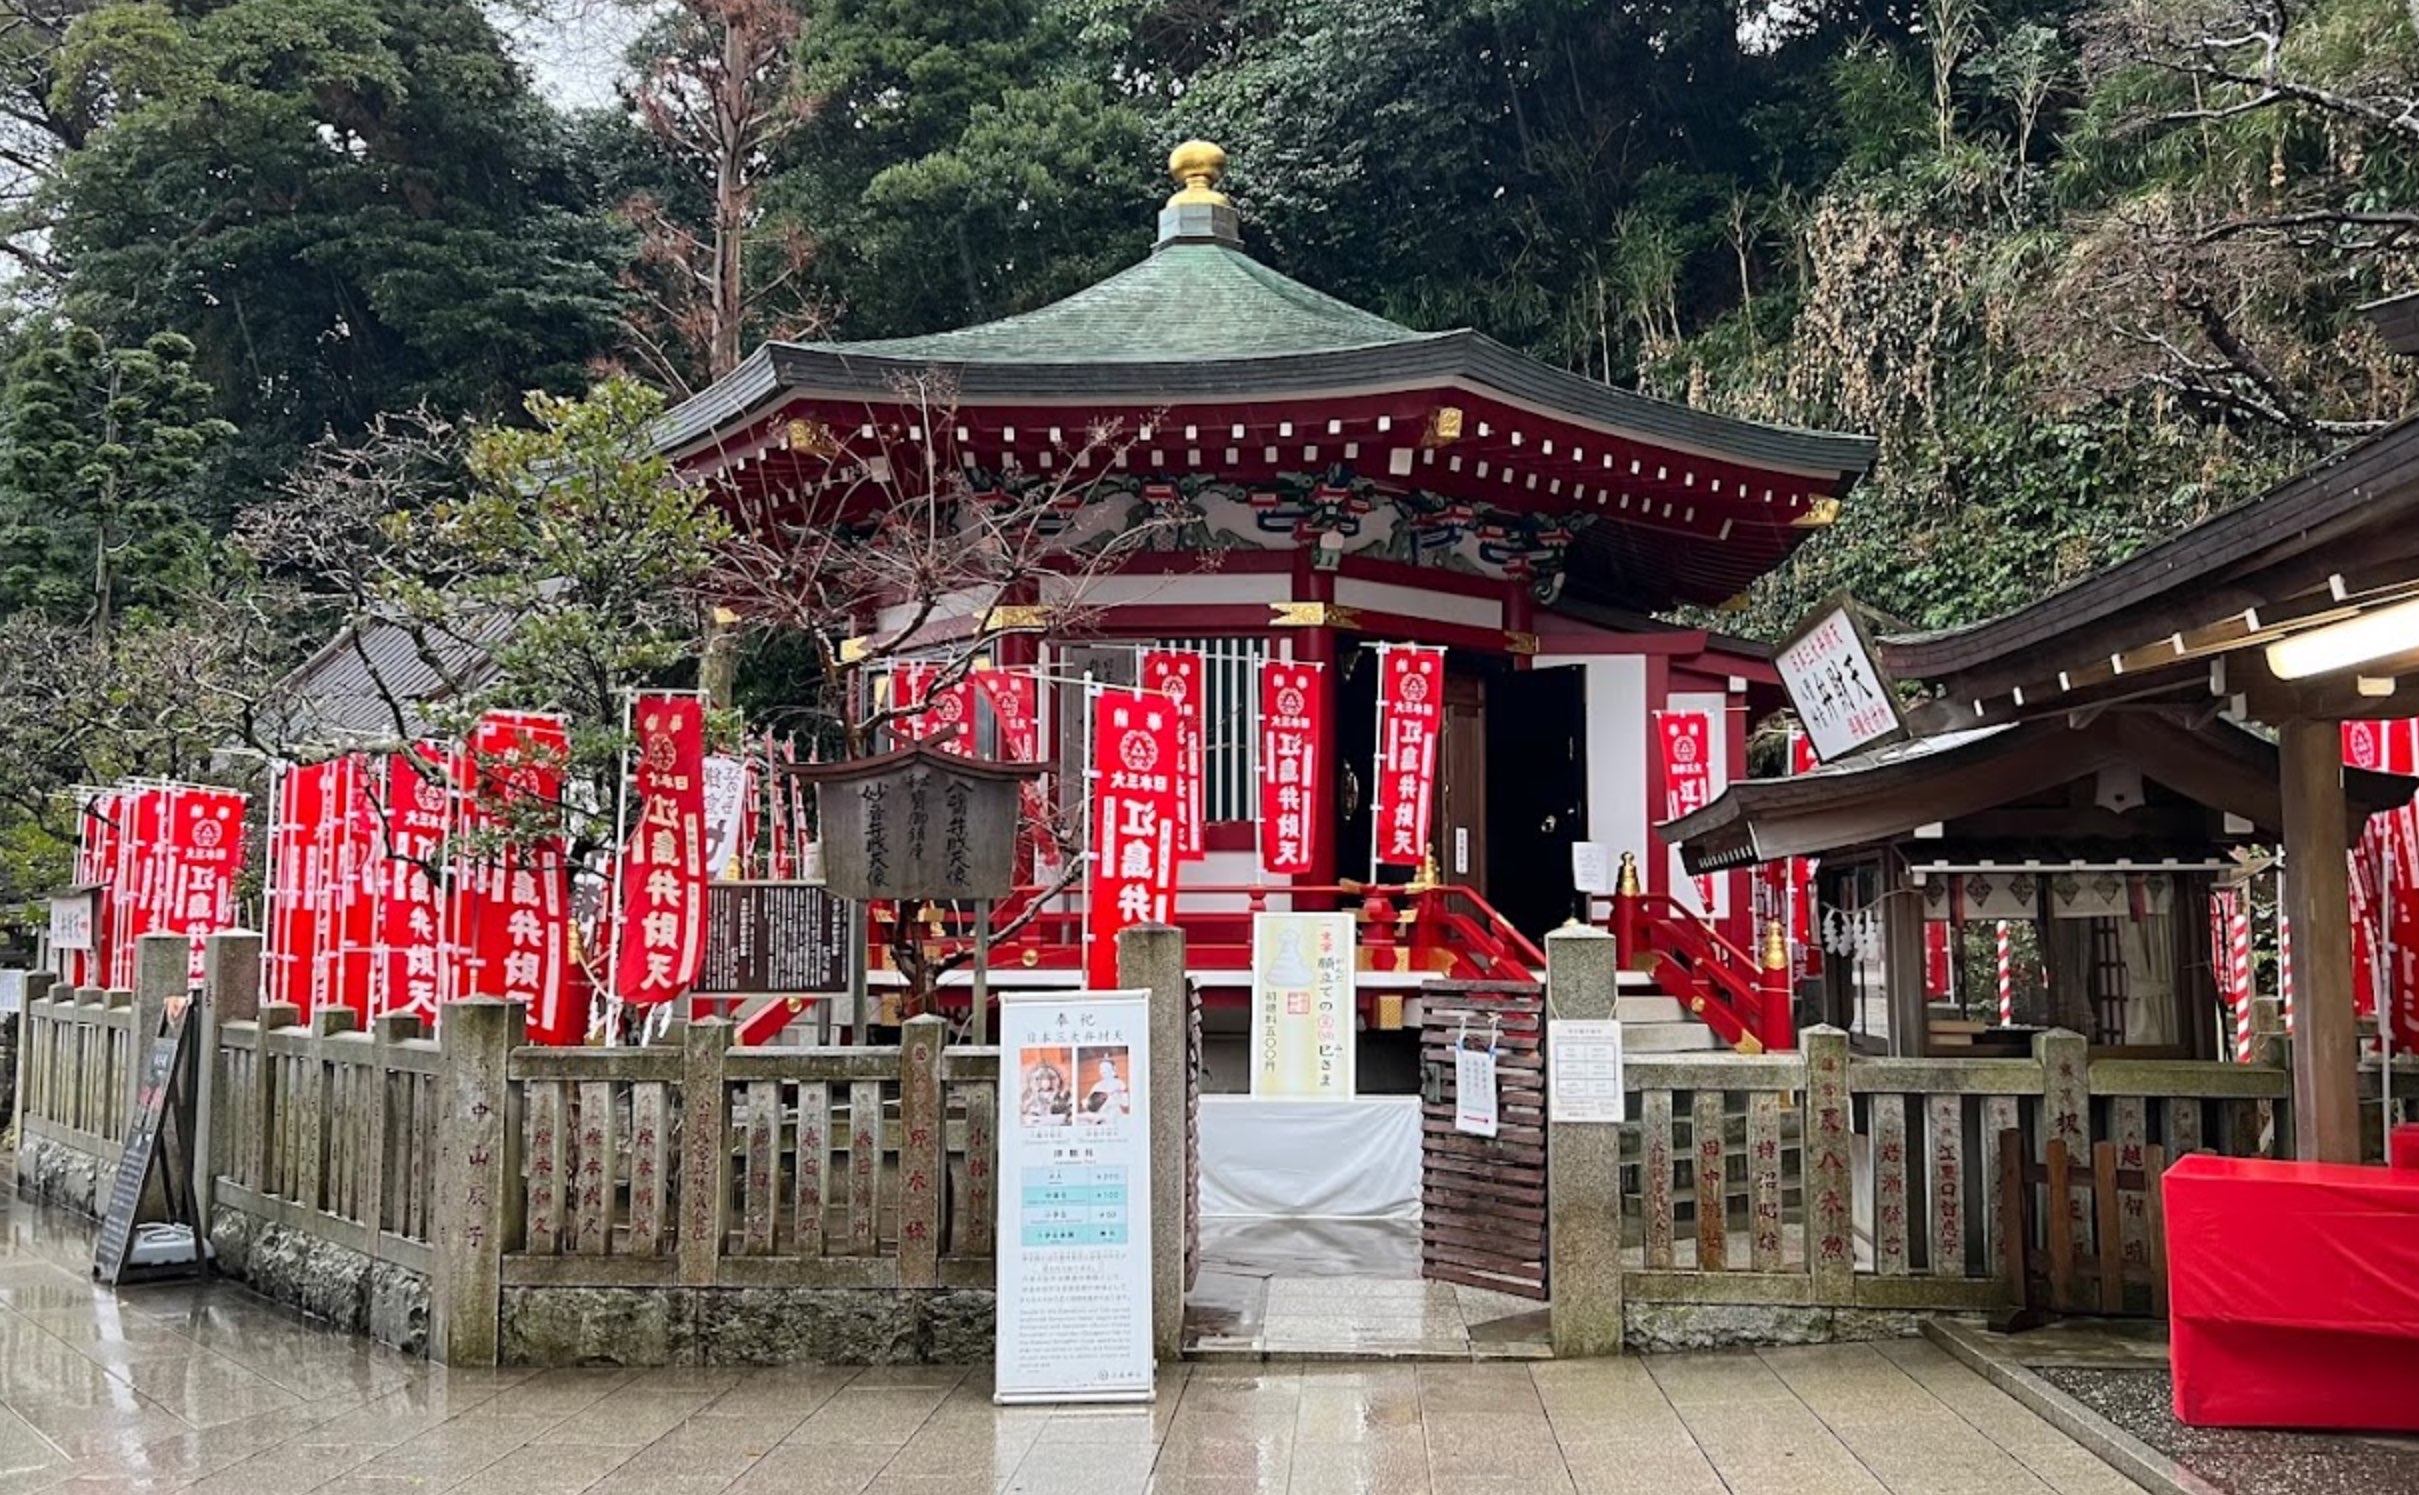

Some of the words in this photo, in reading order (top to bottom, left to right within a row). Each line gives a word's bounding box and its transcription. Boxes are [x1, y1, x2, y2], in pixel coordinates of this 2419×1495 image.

[1027, 1030, 1124, 1043] 日本三大弁財天
